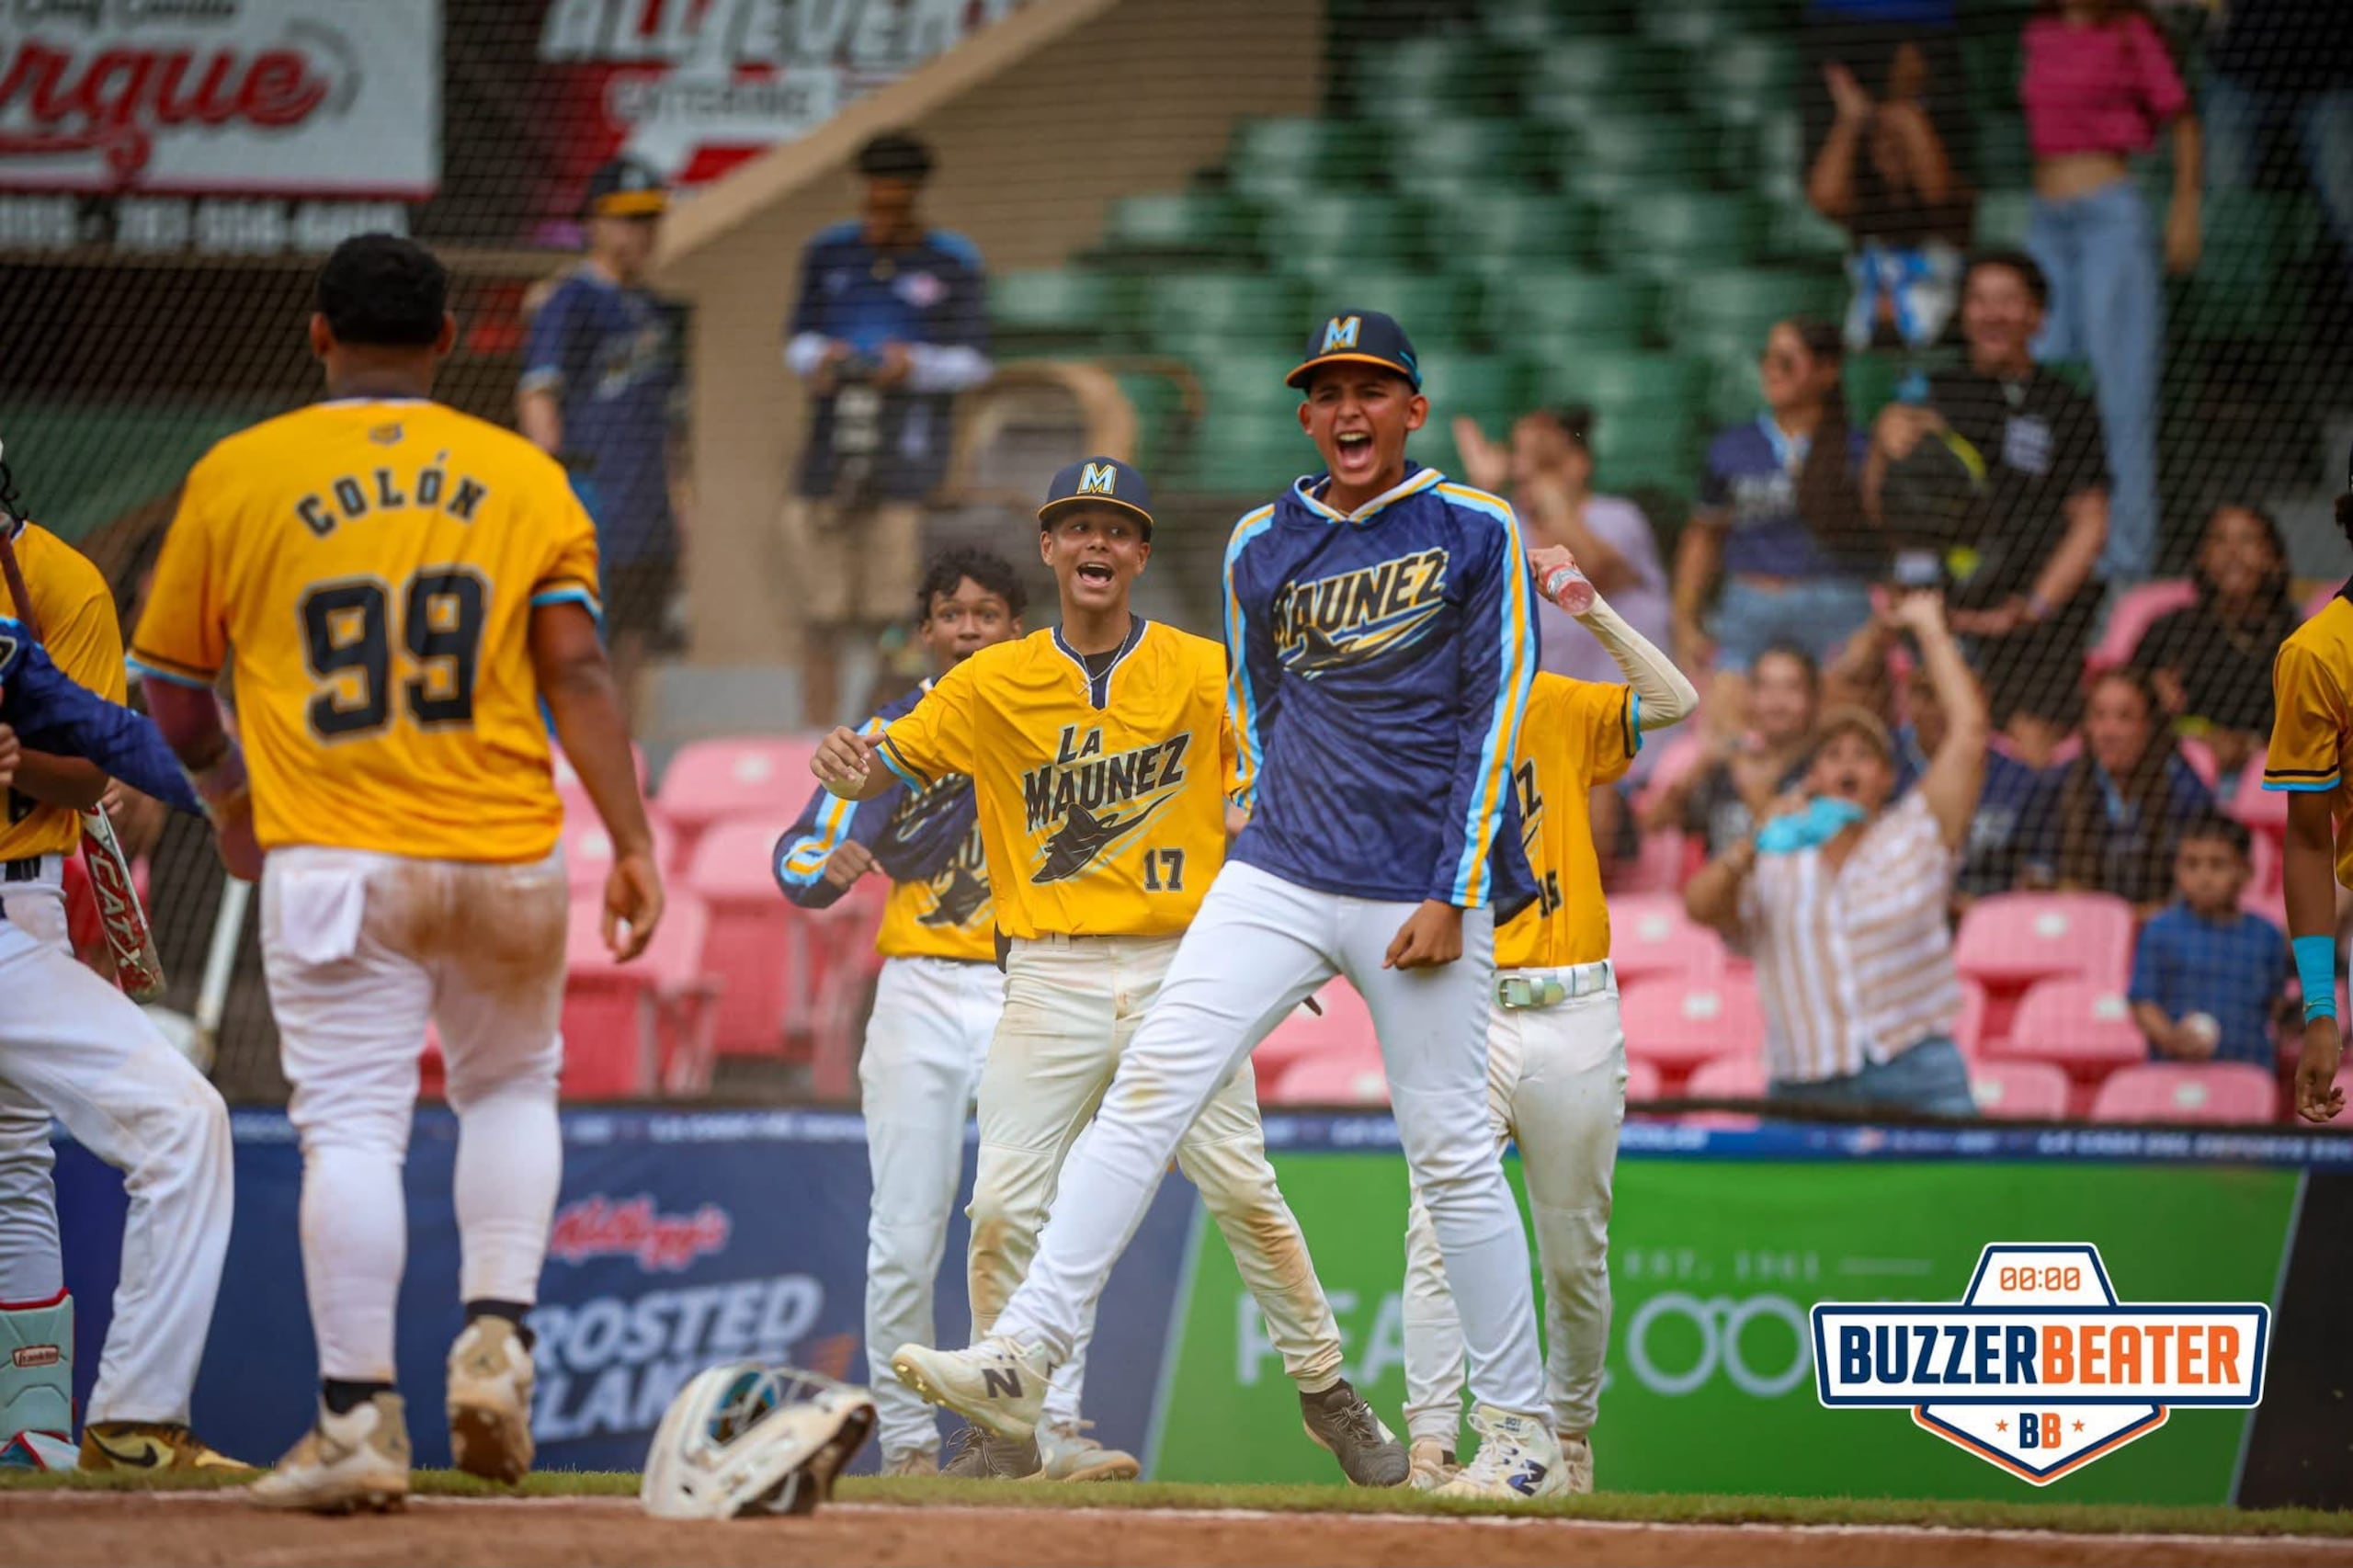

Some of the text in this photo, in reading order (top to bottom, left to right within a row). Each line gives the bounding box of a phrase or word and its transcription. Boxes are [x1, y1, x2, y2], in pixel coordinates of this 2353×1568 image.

[1319, 315, 1361, 355] M
[296, 450, 487, 539] COLÓN
[1076, 462, 1117, 494] M
[296, 563, 494, 746] 99
[1057, 724, 1103, 766] LA
[1023, 731, 1192, 835] MAUNEZ
[1143, 846, 1185, 892] 17
[526, 1278, 823, 1369] ROSTED
[981, 1369, 1023, 1398] N
